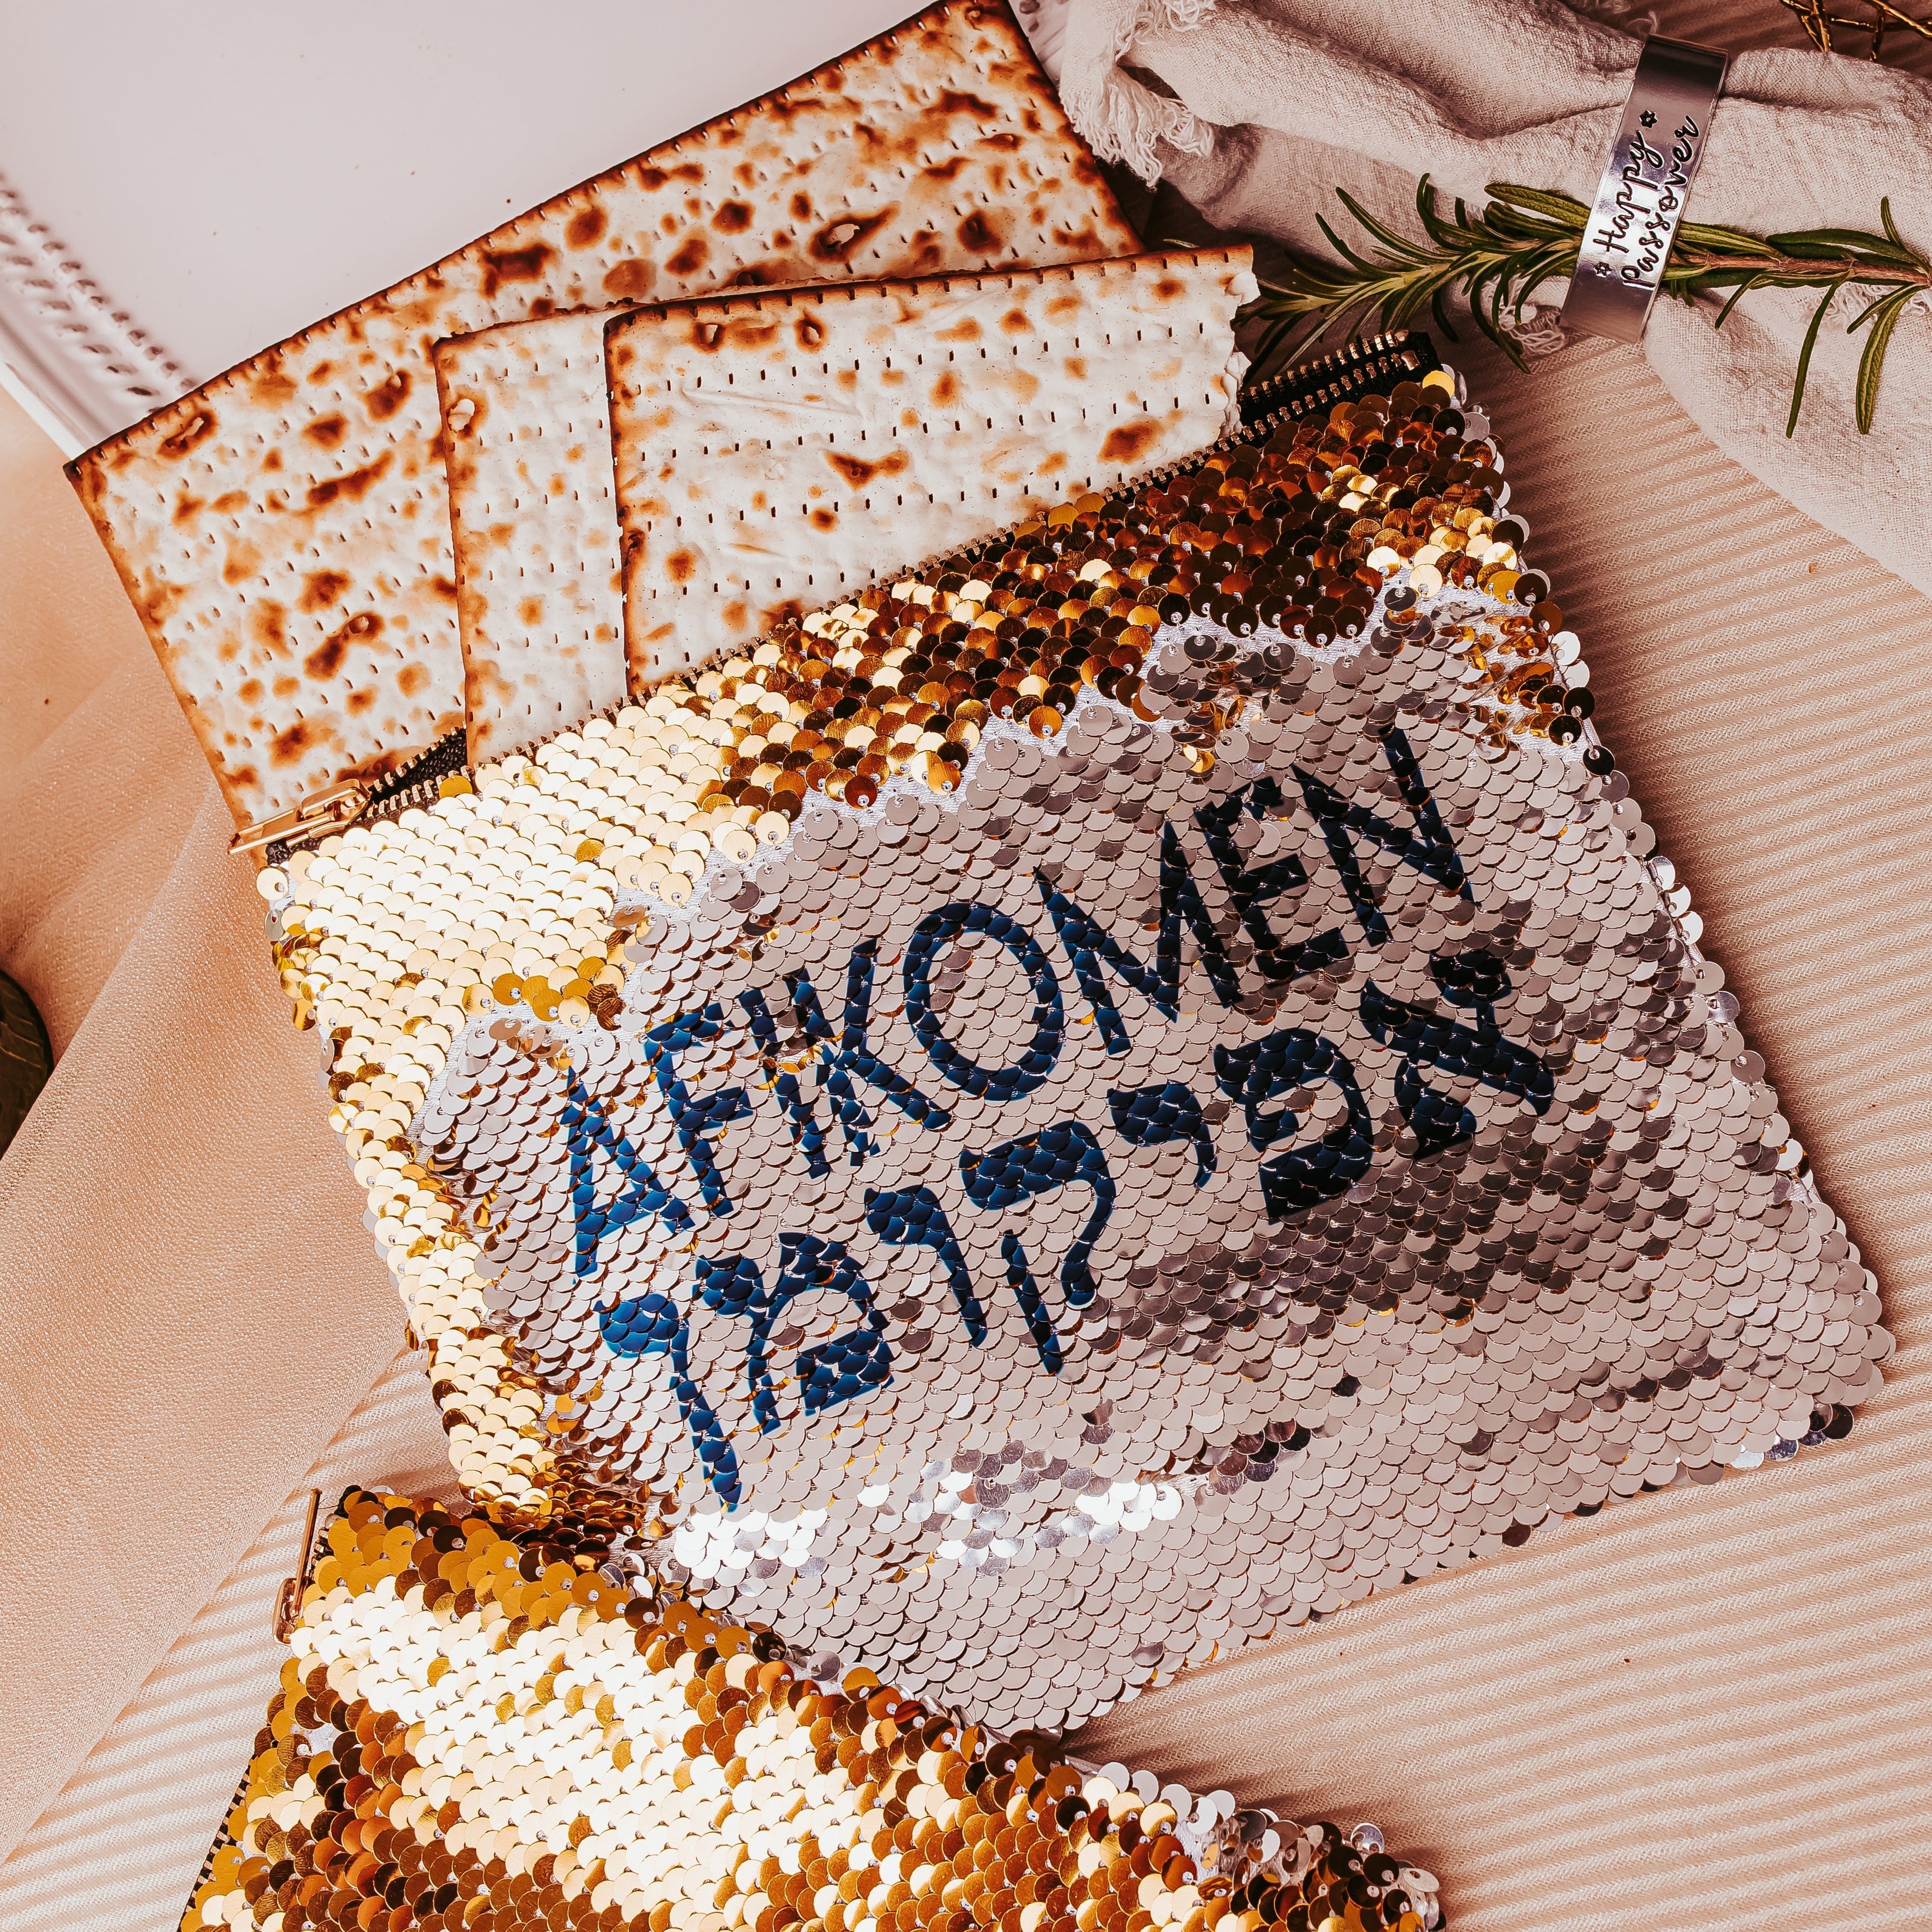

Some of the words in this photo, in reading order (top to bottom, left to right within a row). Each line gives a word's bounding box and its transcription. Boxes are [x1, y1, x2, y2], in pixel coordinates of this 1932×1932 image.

[1593, 130, 1662, 253] Happy
[561, 723, 1480, 1283] AFIKOMEN
[595, 946, 1555, 1511] אפיקומן
